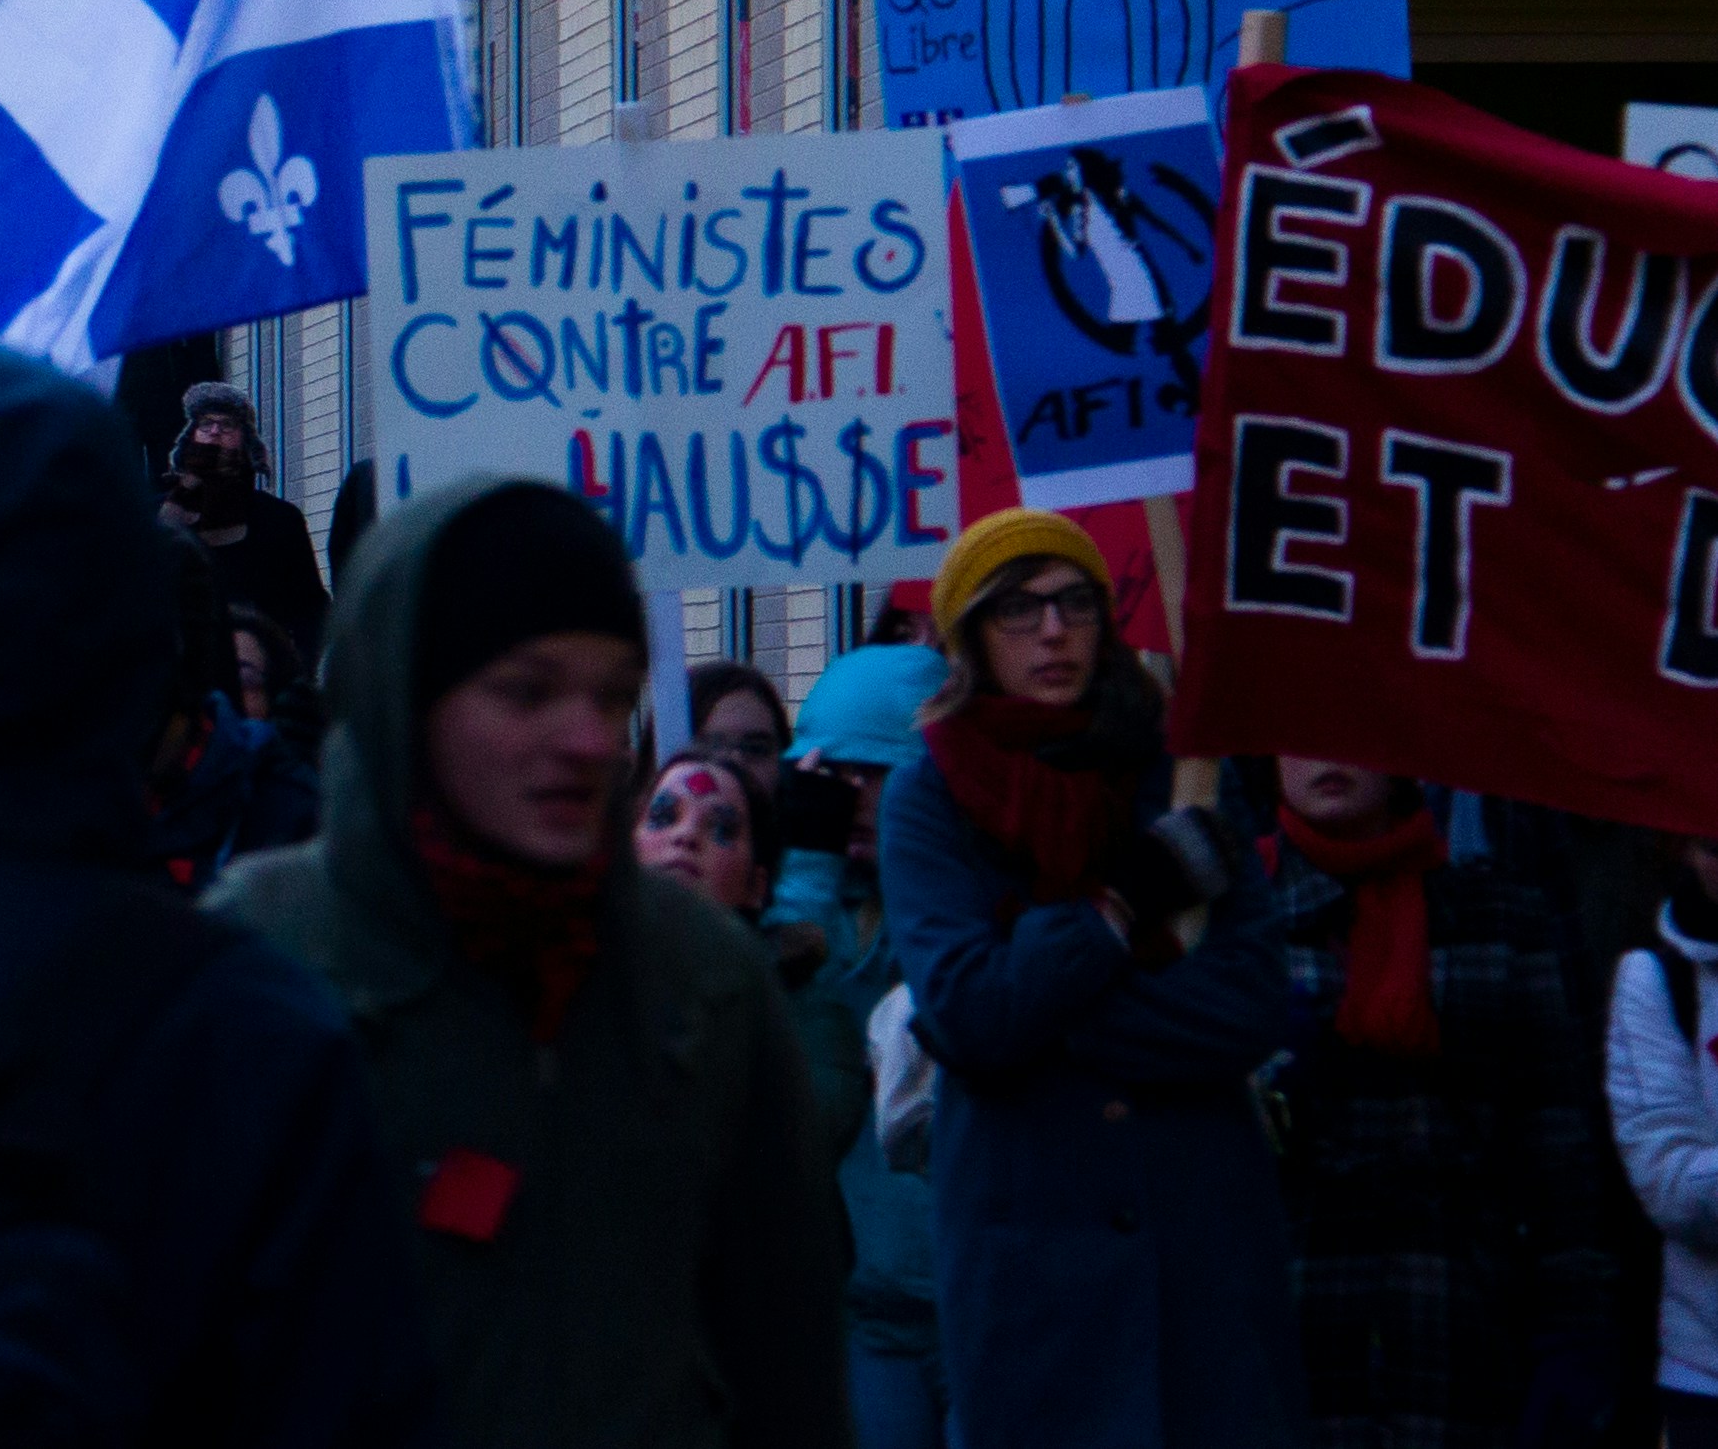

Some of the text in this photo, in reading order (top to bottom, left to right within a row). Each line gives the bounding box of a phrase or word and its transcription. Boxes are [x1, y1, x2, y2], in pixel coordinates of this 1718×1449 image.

[882, 20, 978, 74] Libre
[390, 297, 729, 419] CONTRE
[1017, 376, 1145, 445] AFI
[1225, 414, 1513, 662] ET
